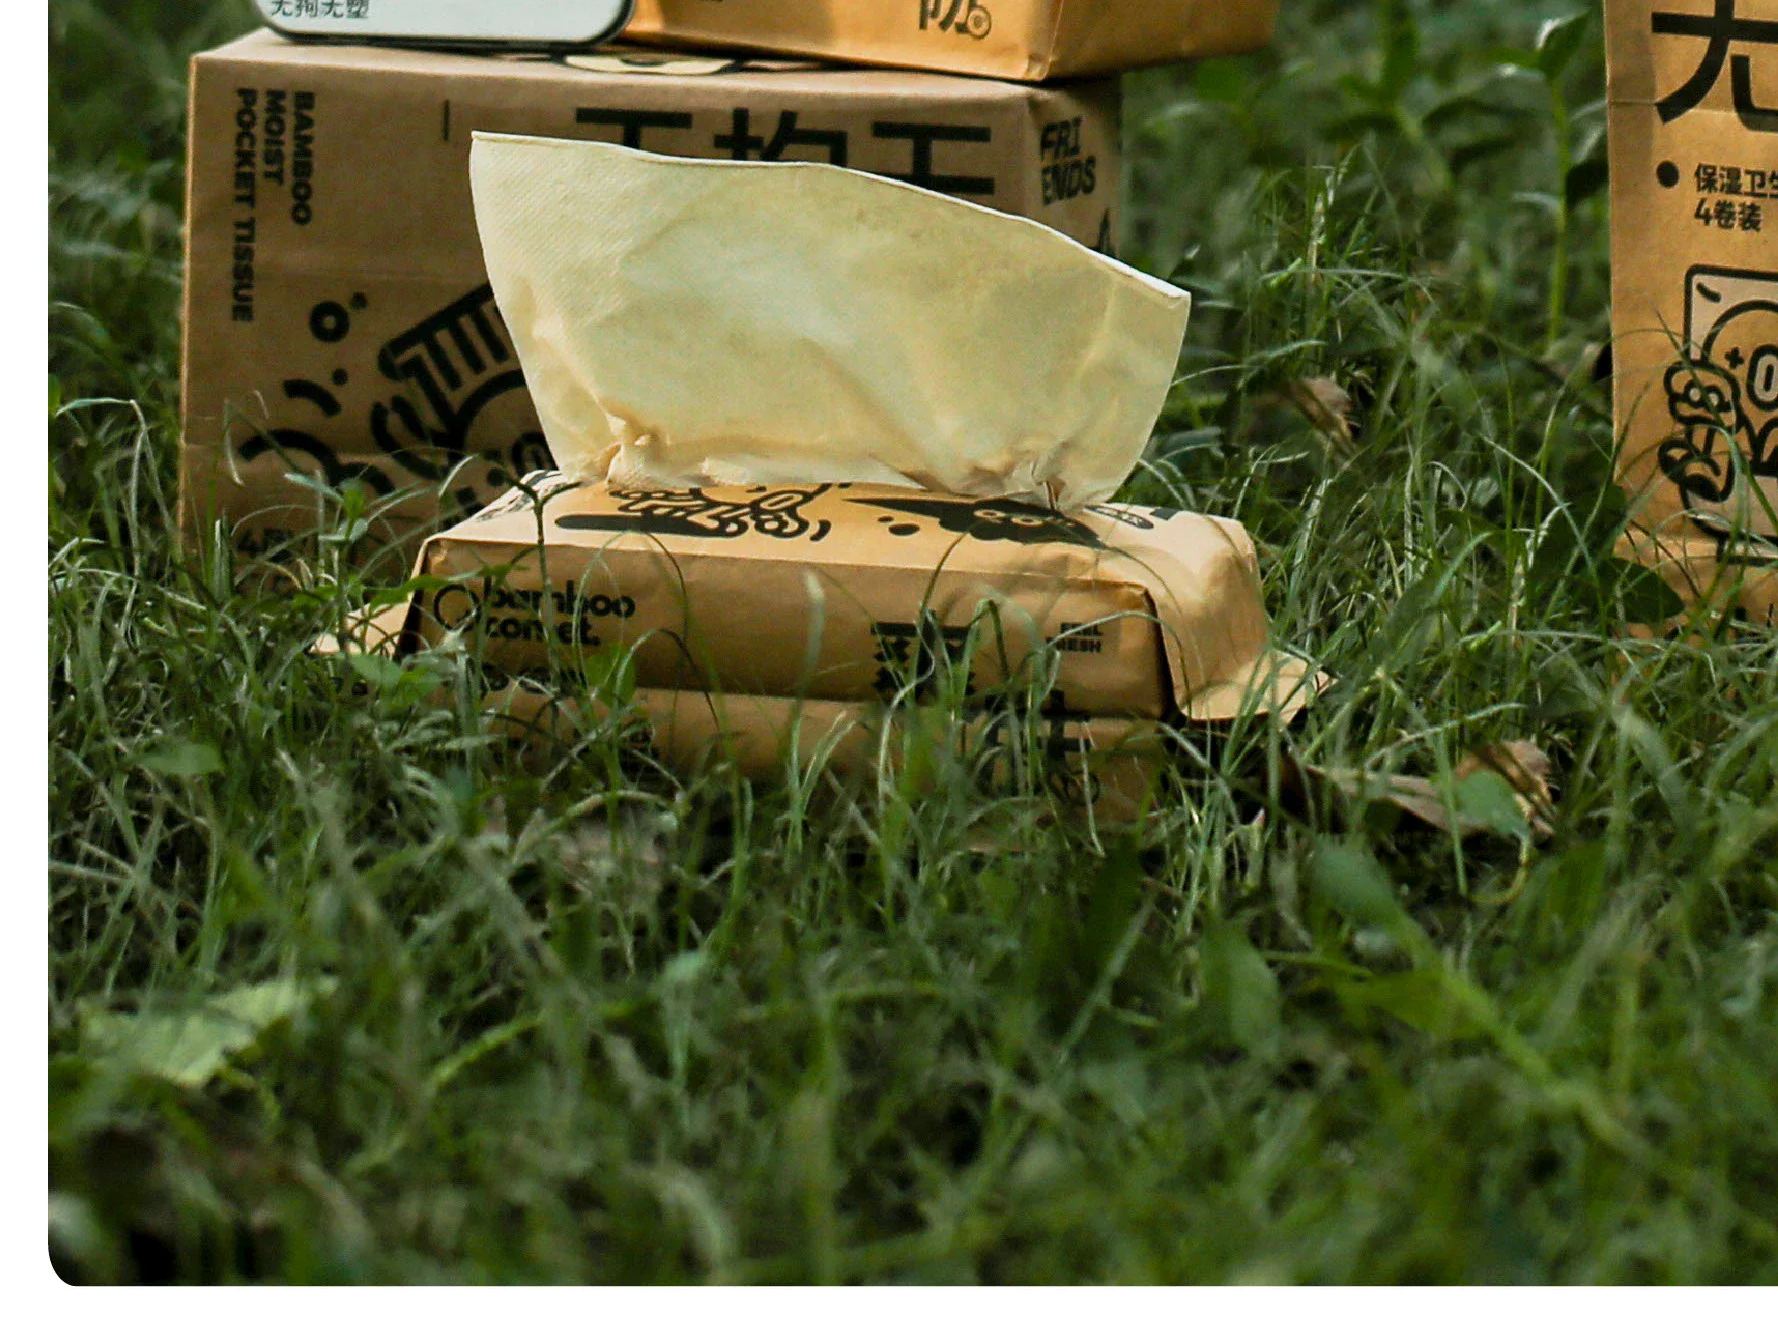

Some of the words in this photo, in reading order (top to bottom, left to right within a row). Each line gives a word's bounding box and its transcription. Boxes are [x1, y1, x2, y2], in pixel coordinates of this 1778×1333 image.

[234, 88, 258, 210] POCKET
[262, 89, 287, 187] MOIST
[291, 91, 316, 226] BAMBOO
[1040, 115, 1083, 161] FRI
[1041, 155, 1097, 206] ENDS
[1694, 199, 1763, 233] 4卷装
[231, 215, 256, 322] TISSUE
